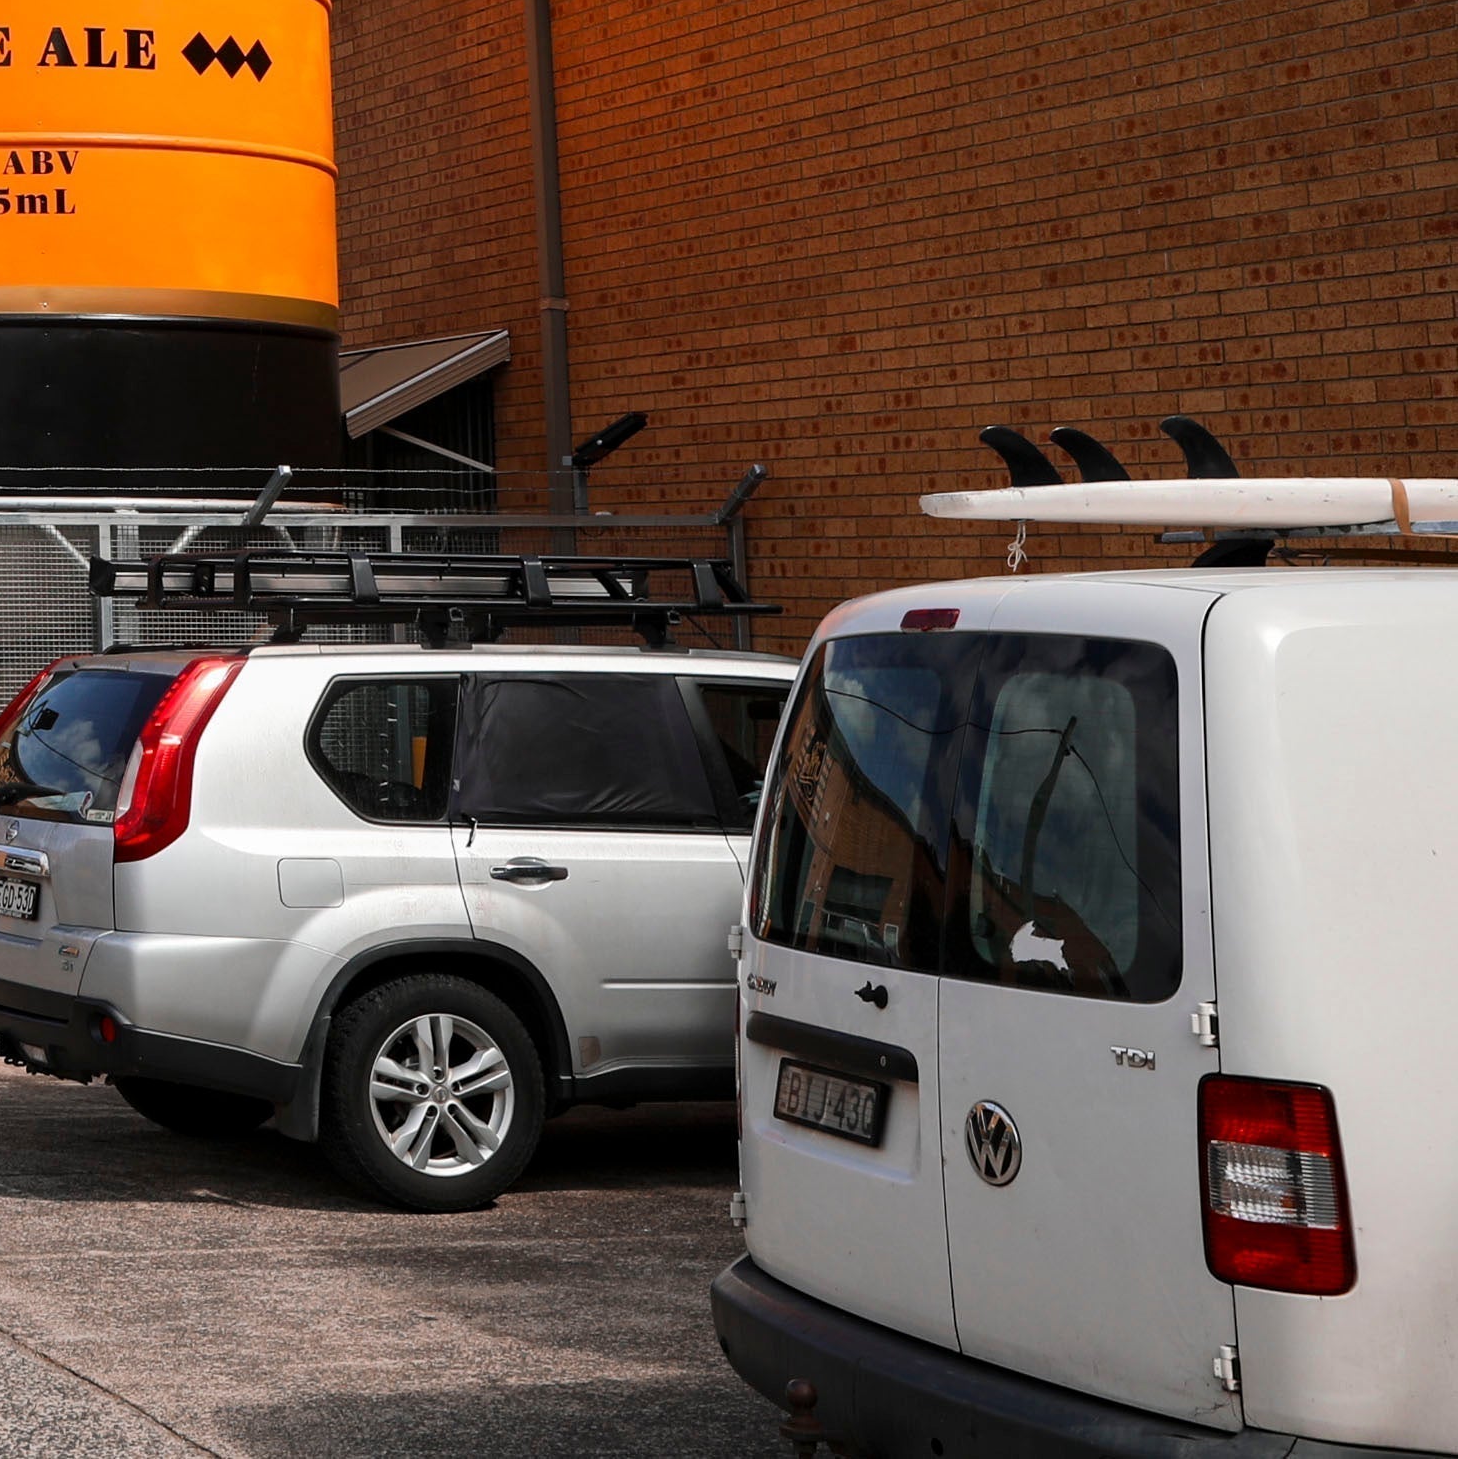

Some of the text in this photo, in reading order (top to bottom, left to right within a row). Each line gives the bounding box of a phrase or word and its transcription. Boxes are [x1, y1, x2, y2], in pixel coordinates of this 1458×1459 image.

[36, 26, 158, 71] ALE
[1, 149, 81, 176] ABV
[1110, 1044, 1156, 1071] TDI
